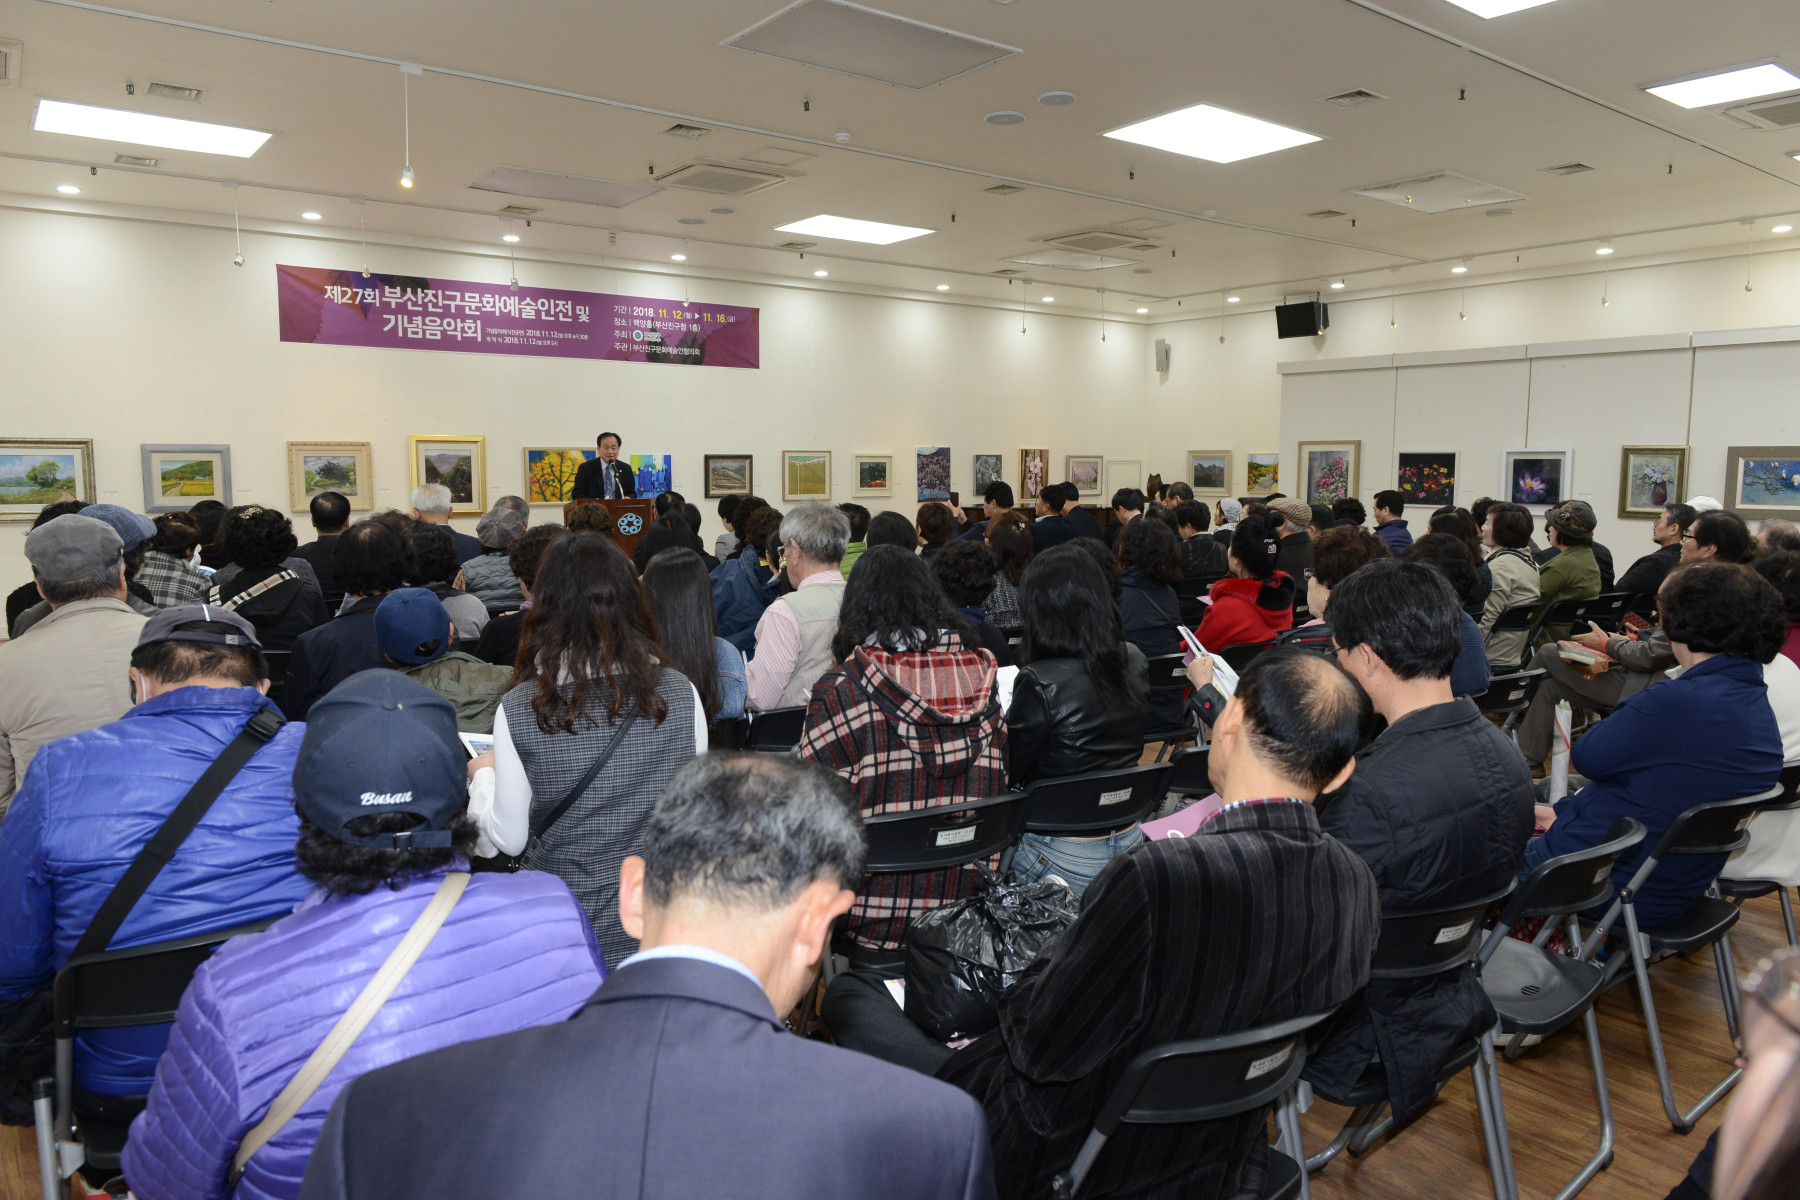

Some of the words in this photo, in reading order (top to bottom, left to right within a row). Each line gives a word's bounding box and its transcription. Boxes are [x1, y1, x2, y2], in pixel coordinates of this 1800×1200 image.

[324, 285, 380, 308] 제27회
[382, 286, 573, 322] 부산진구문화예술인전
[576, 305, 590, 323] 및
[613, 305, 627, 314] 기간
[633, 306, 656, 317] 2018.
[658, 308, 669, 319] 11.
[703, 312, 713, 322] 11.
[382, 314, 482, 342] 기념음악회
[613, 317, 627, 326] 장소
[689, 323, 701, 333] 1층)
[613, 330, 628, 339] 주최
[614, 342, 628, 352] 주관
[360, 791, 413, 806] Busan
